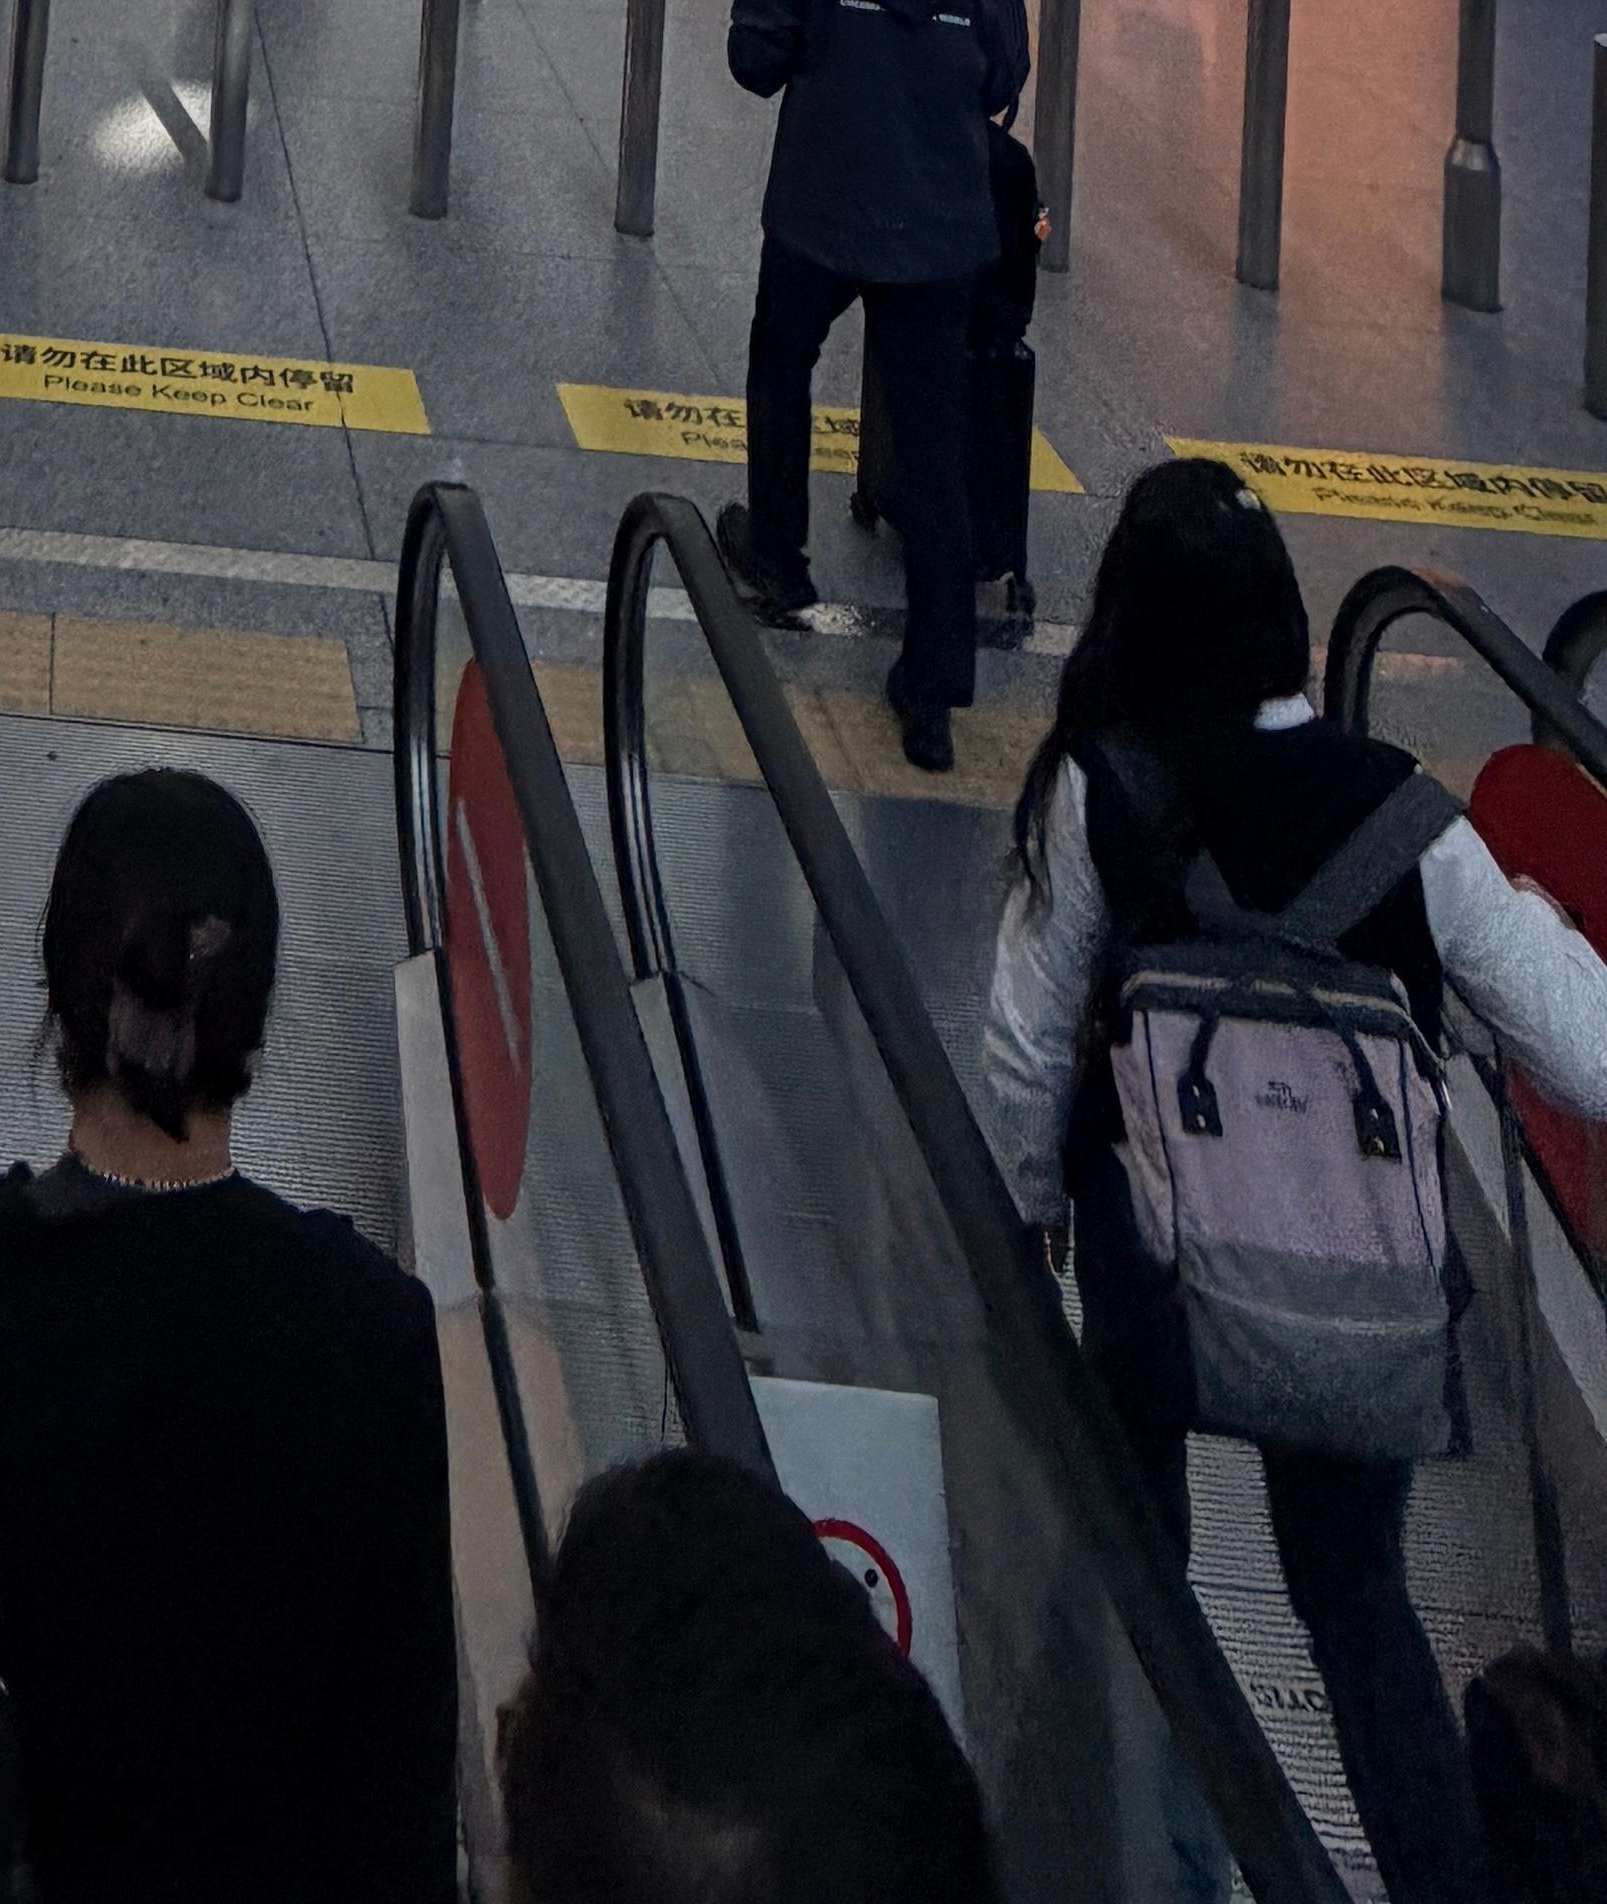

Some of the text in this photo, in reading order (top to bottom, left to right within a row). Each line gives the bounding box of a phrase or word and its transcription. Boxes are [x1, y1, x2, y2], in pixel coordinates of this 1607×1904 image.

[0, 343, 354, 393] 请勿在此区域内停留
[44, 374, 314, 412] Please Keep Clear
